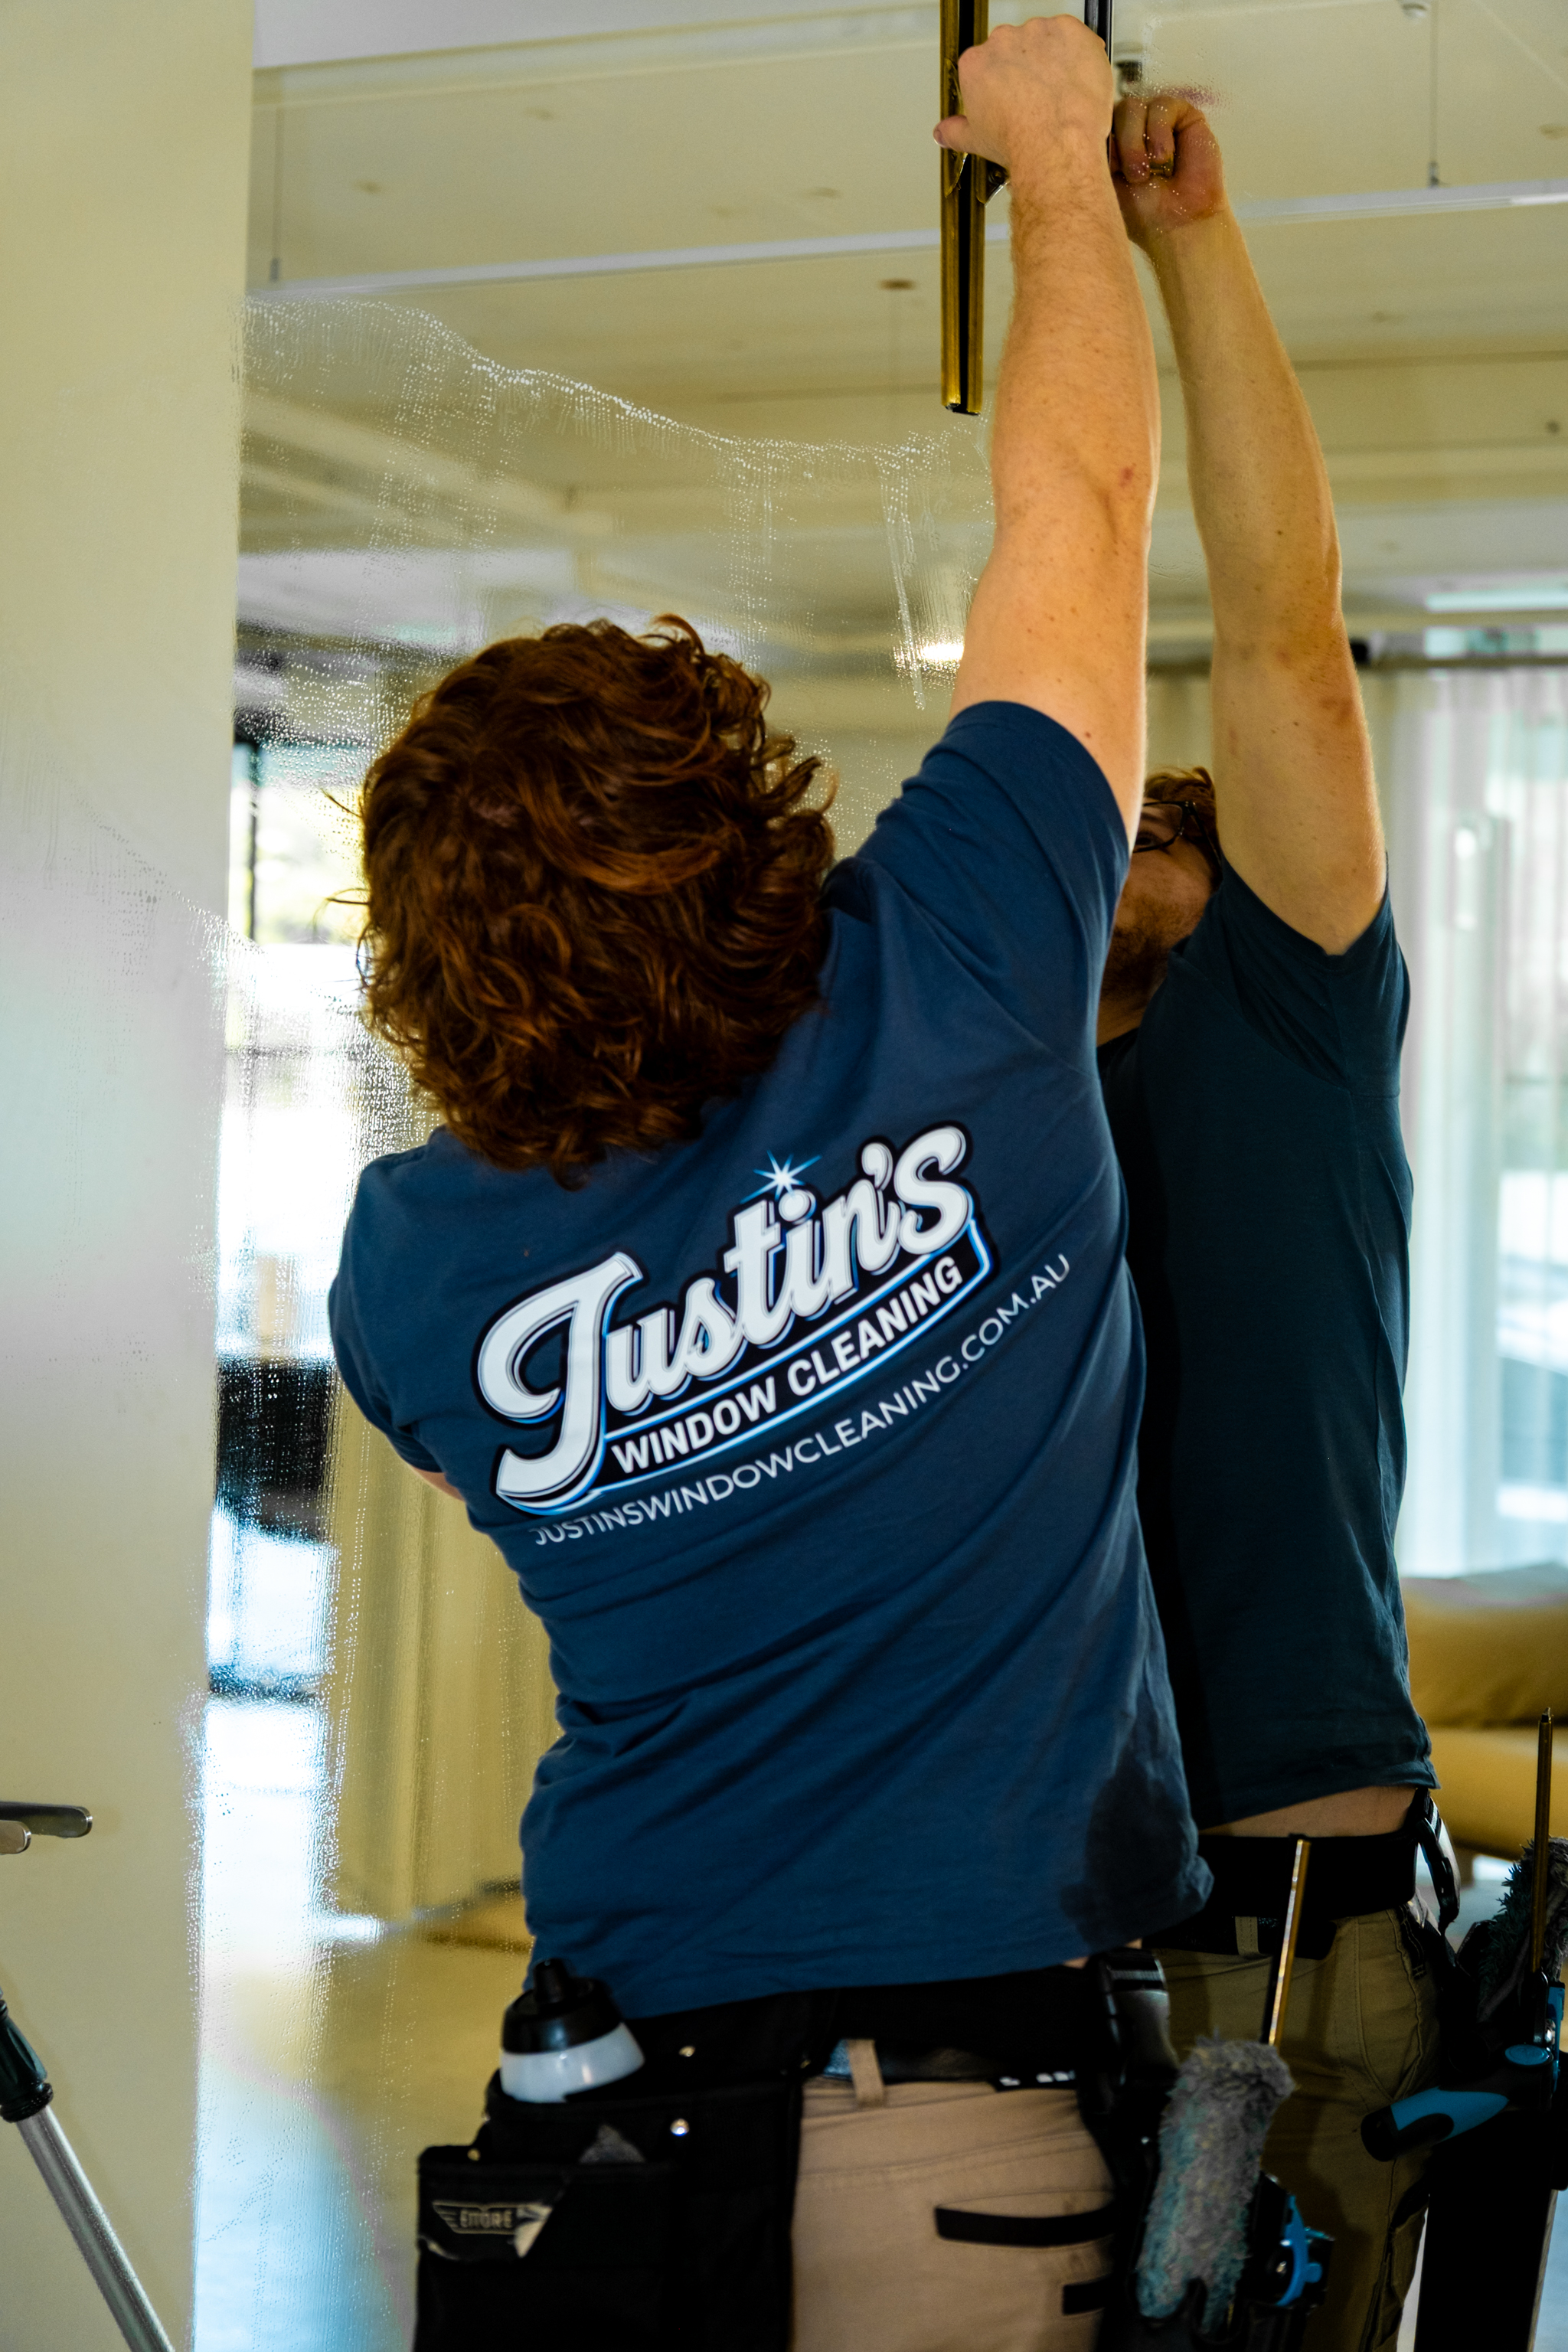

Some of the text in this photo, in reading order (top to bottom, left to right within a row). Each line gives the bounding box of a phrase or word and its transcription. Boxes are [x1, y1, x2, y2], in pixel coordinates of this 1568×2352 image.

[529, 1253, 1071, 1546] JUSTINSWINDOWCLEANING.COM.AU
[610, 1256, 964, 1474] WINDOW CLEANING
